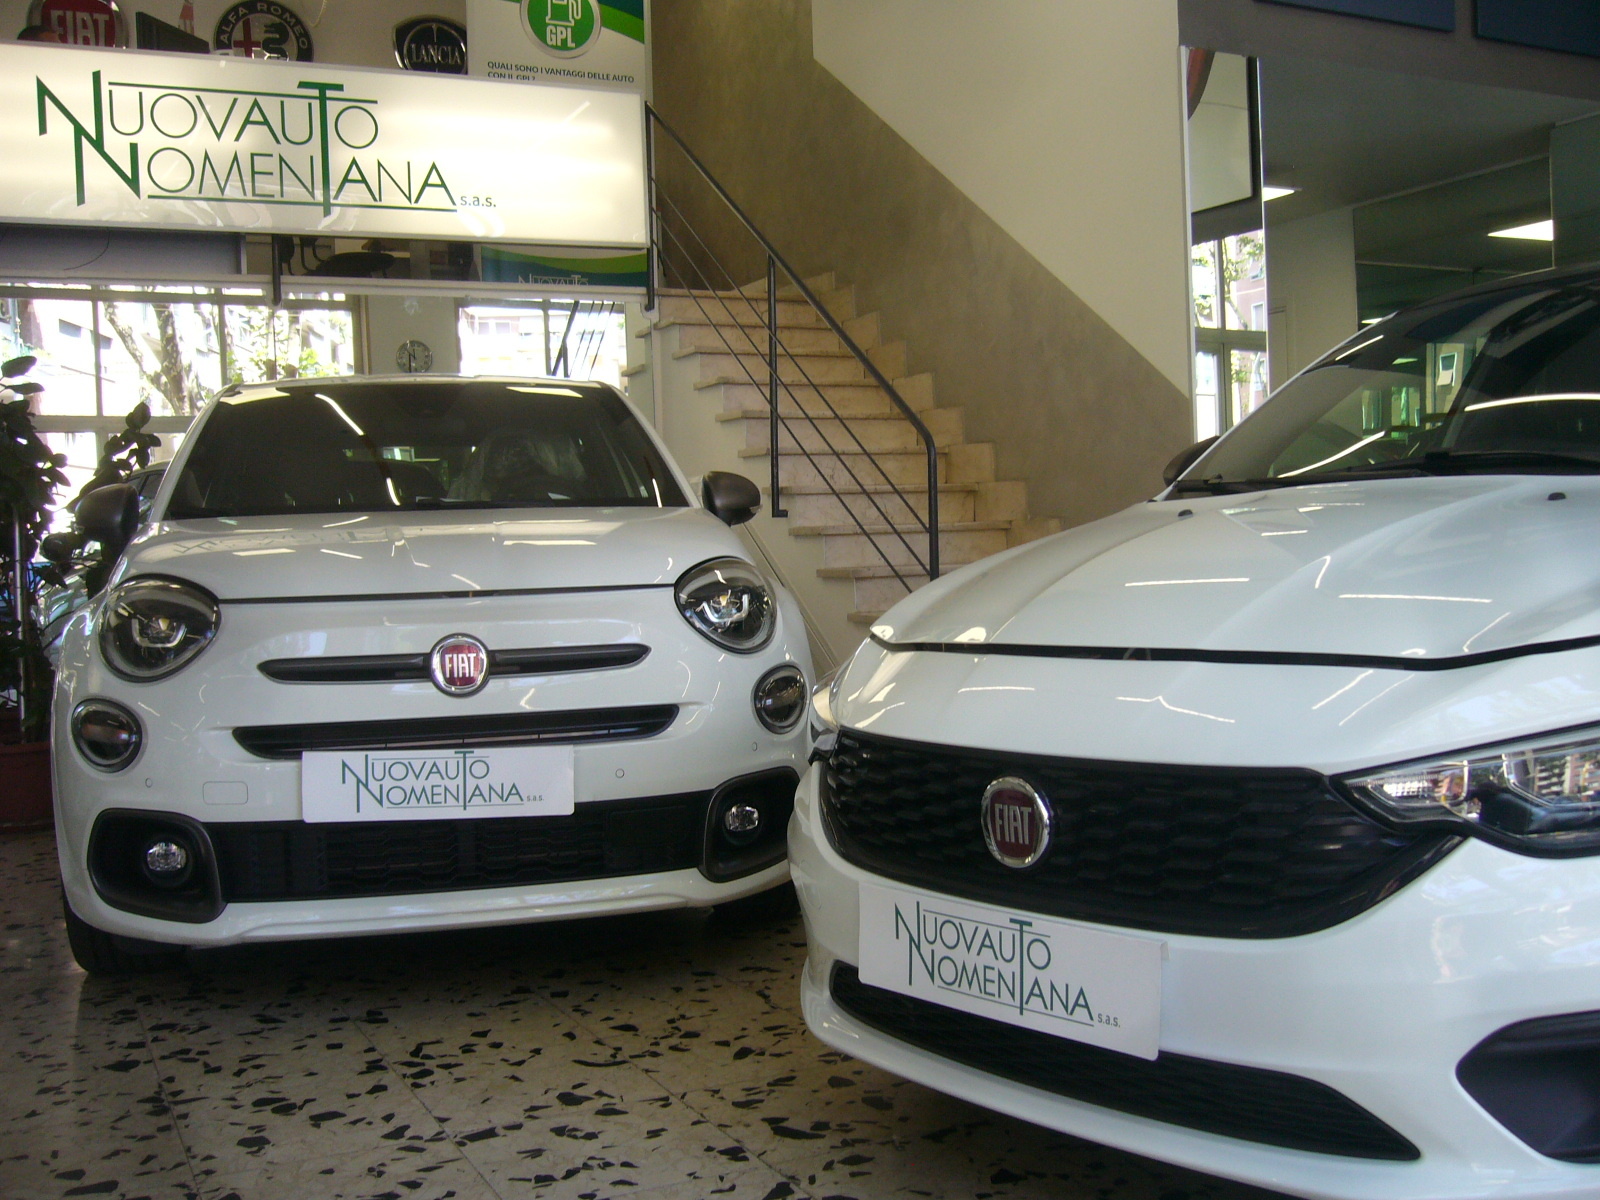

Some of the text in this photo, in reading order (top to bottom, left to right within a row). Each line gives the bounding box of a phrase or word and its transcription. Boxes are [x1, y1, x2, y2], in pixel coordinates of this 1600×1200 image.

[50, 9, 110, 47] FIAT
[220, 2, 308, 49] ALFA ROMEO
[546, 25, 576, 48] GPL
[410, 44, 463, 65] LANCIA
[487, 61, 513, 71] QUALI
[514, 63, 539, 73] SONO
[544, 67, 586, 79] VANTAGGI
[587, 71, 610, 81] DELLE
[611, 74, 635, 83] AUTO
[36, 70, 379, 150] NUOVAUTO
[74, 140, 497, 218] NOMENTANA s.a.s.
[444, 652, 477, 679] FIAT
[341, 750, 490, 786] NUOVAUTO
[355, 777, 524, 813] NOMENTANA
[994, 802, 1032, 846] FIAT
[895, 900, 1052, 972] NUOVAUTO
[907, 938, 1122, 1029] NOMENTANA s.a.s.
